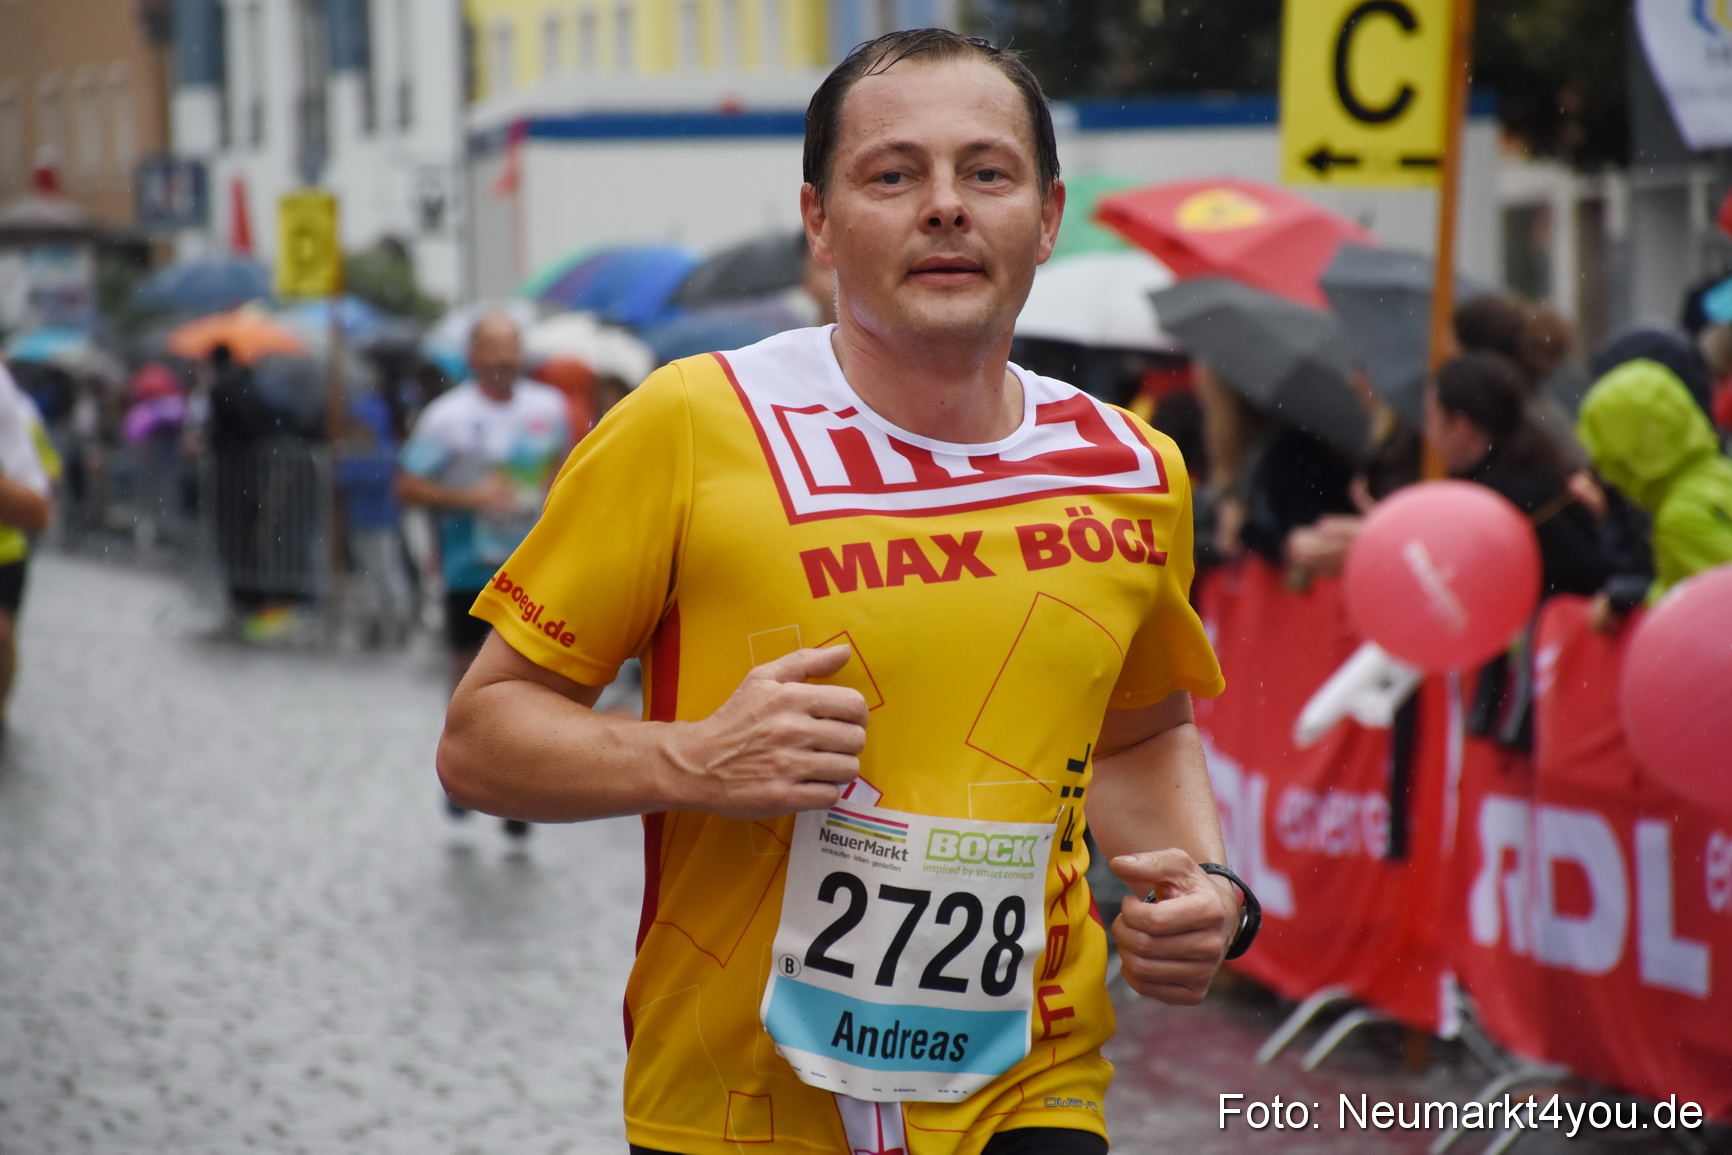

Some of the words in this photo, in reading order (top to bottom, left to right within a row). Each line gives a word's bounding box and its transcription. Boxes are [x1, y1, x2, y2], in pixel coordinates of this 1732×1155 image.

[1334, 0, 1418, 124] C
[800, 530, 997, 599] MAX
[1015, 506, 1168, 572] BÖGL
[819, 827, 909, 862] NeuerMarkt
[821, 847, 850, 859] einkaufen
[853, 854, 869, 864] leben
[871, 860, 901, 872] genießen
[925, 828, 1039, 868] BOCK
[922, 863, 960, 875] inspired
[962, 866, 974, 878] by
[975, 868, 1002, 879] smart
[1003, 870, 1034, 881] concepts
[1469, 795, 1712, 999] RDL
[803, 871, 1026, 997] 2728
[785, 957, 795, 975] B
[831, 1010, 969, 1063] Andreas
